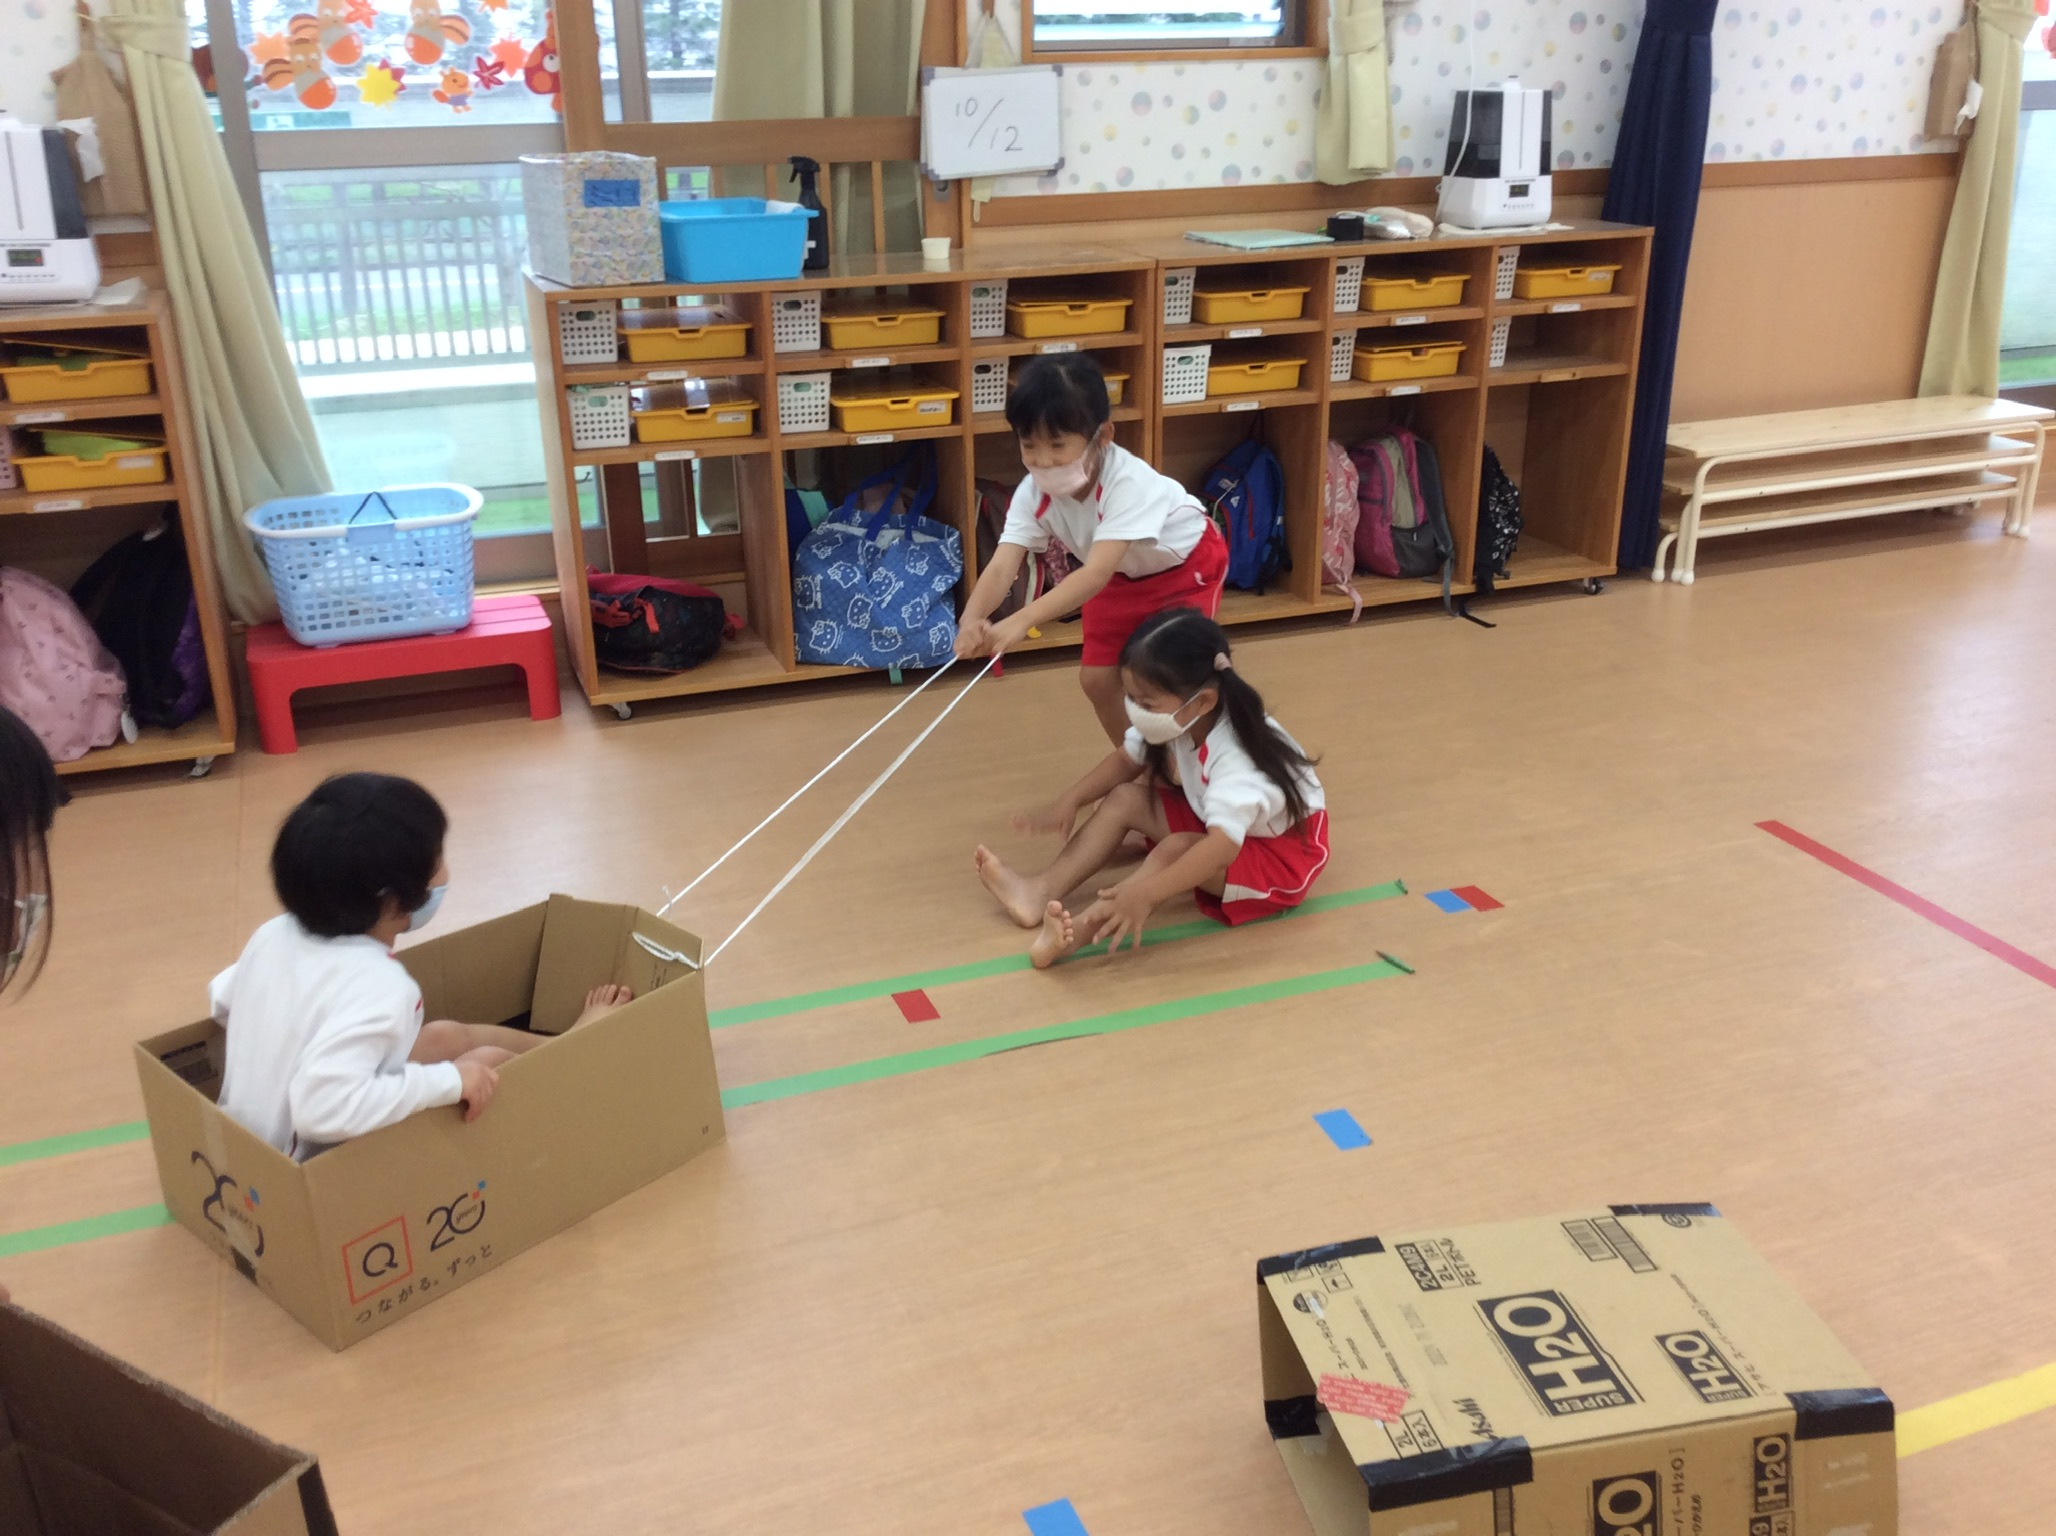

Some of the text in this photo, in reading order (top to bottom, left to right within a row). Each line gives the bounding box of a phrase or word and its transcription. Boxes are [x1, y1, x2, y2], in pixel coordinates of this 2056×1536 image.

[363, 1242, 398, 1277] Q
[1436, 1264, 1455, 1282] 2L
[1493, 1297, 1617, 1401] H2O
[1665, 1334, 1742, 1394] H2O
[1553, 1392, 1625, 1413] SUPER
[1395, 1429, 1414, 1448] 2L
